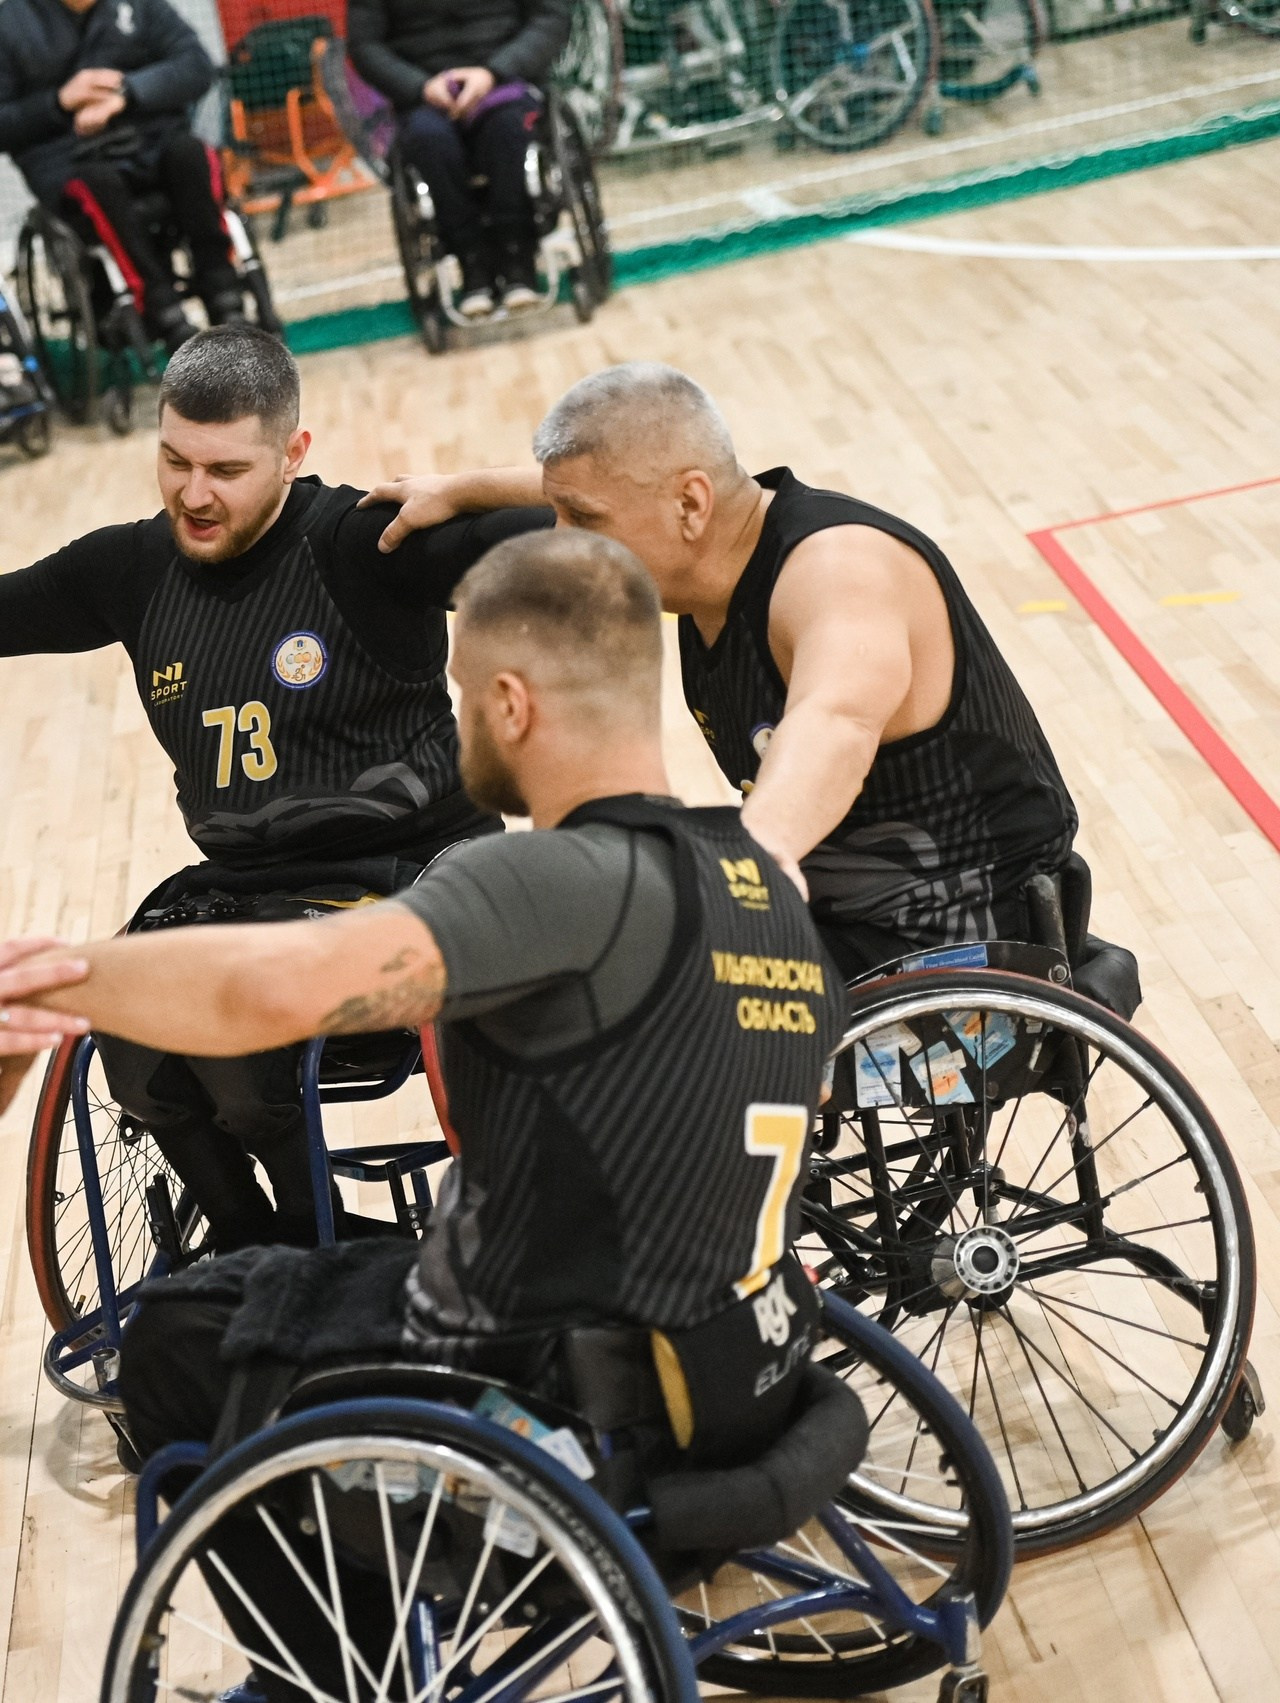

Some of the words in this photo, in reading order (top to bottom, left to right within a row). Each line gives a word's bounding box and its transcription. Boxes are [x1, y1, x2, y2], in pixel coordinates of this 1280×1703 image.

[150, 680, 187, 700] SPORT
[202, 700, 278, 788] 73
[711, 951, 825, 995] УЛЬЯНОВСКАЯ
[737, 996, 816, 1034] ОБЛАСТЬ
[732, 1103, 808, 1300] 7
